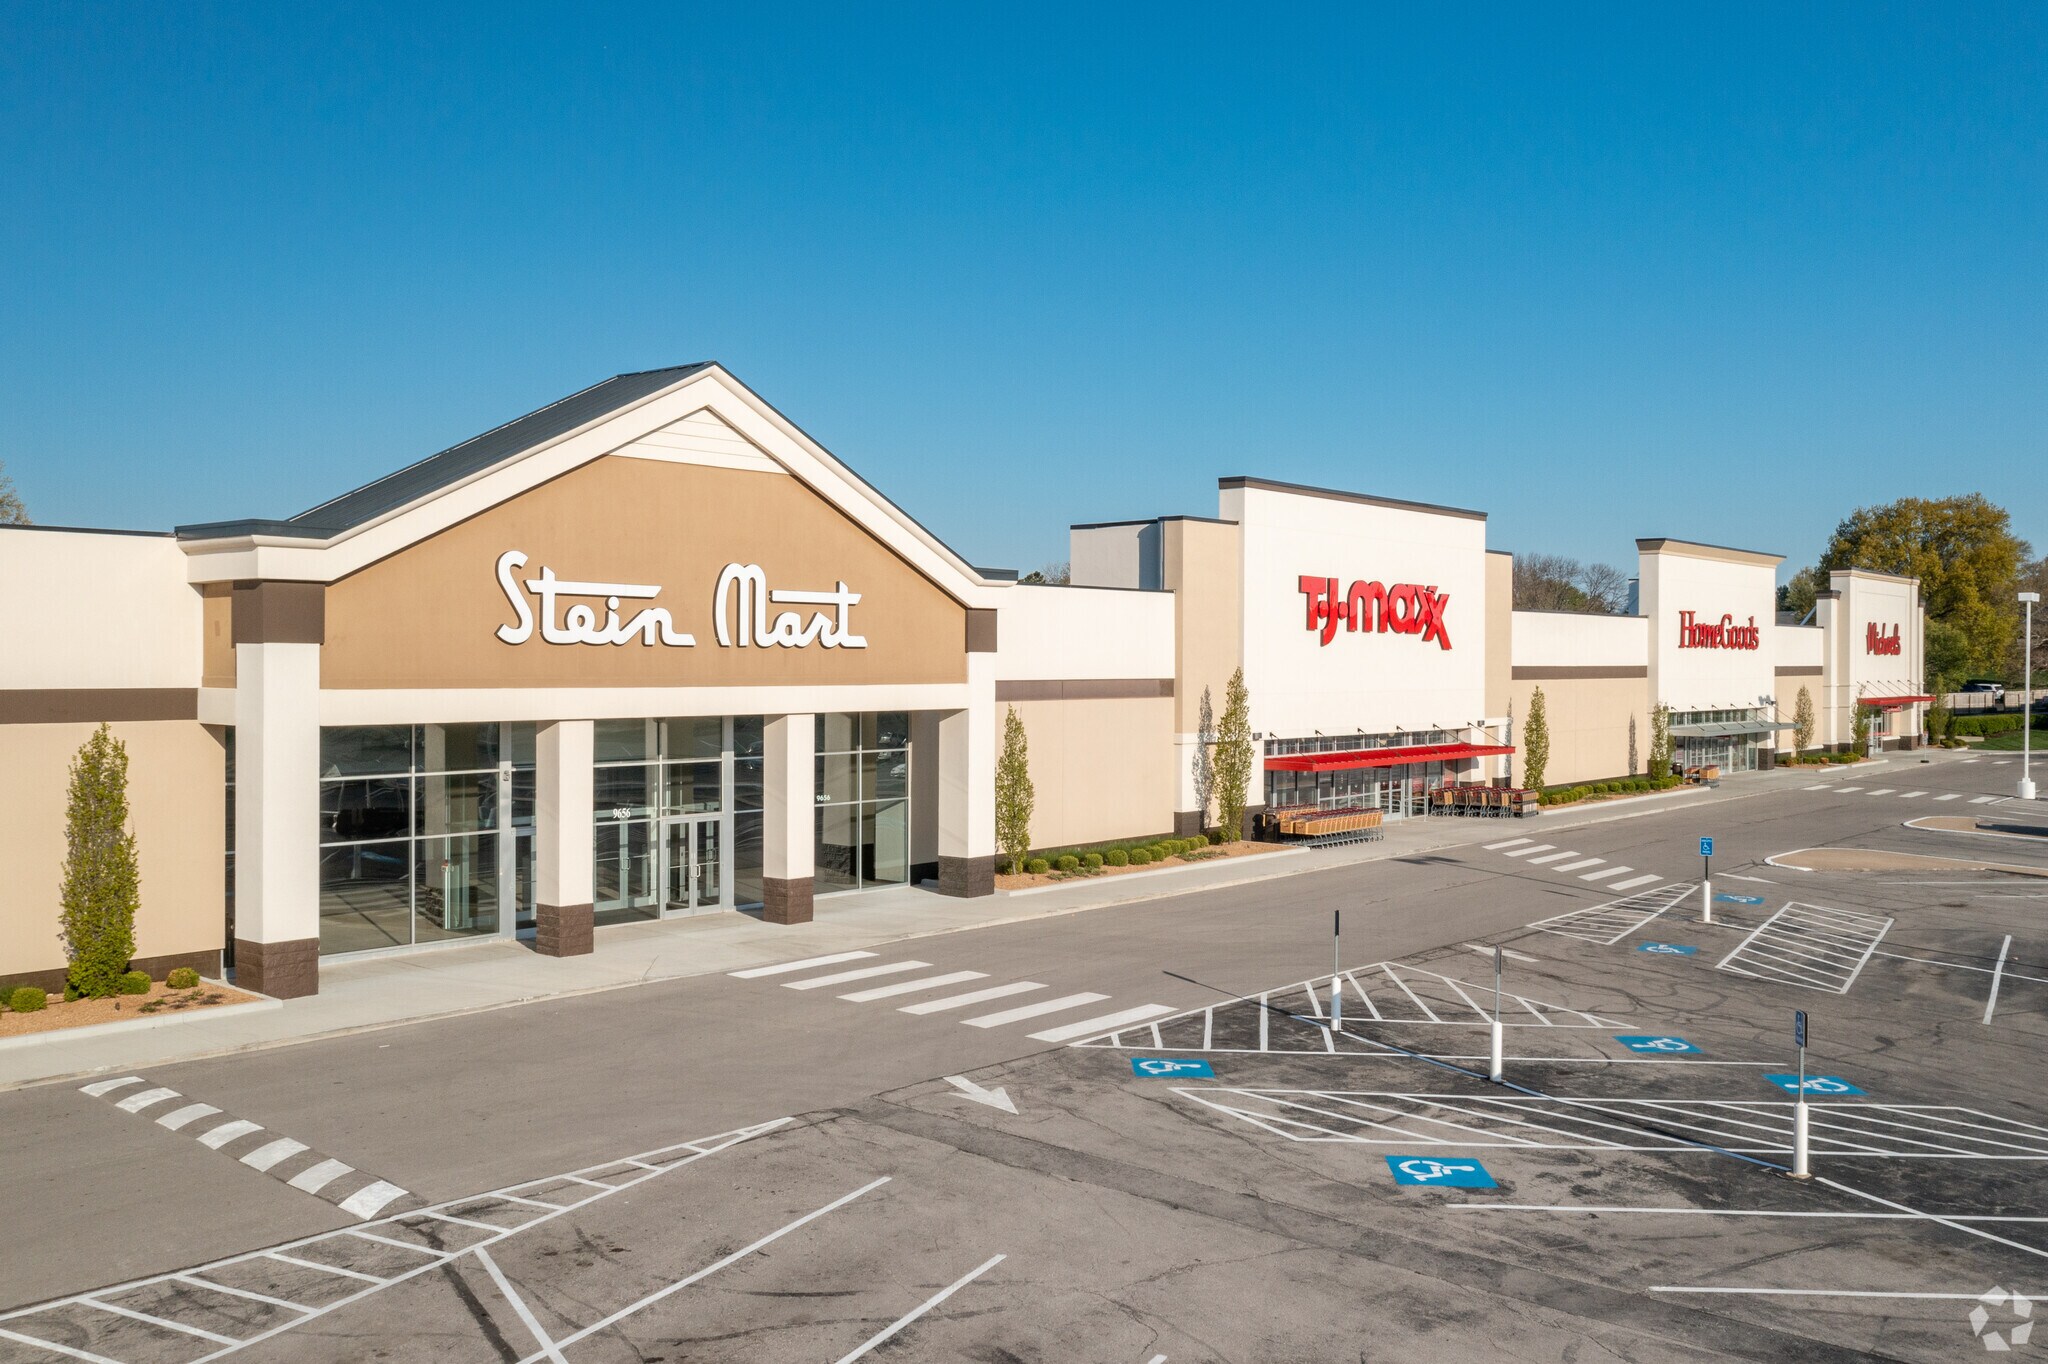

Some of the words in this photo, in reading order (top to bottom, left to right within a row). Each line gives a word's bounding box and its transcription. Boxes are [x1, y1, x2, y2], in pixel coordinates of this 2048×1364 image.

[495, 549, 696, 645] Stein
[712, 562, 868, 648] Mart
[1678, 610, 1760, 651] HomeGoods
[816, 794, 831, 802] 9656
[612, 807, 631, 819] 9656
